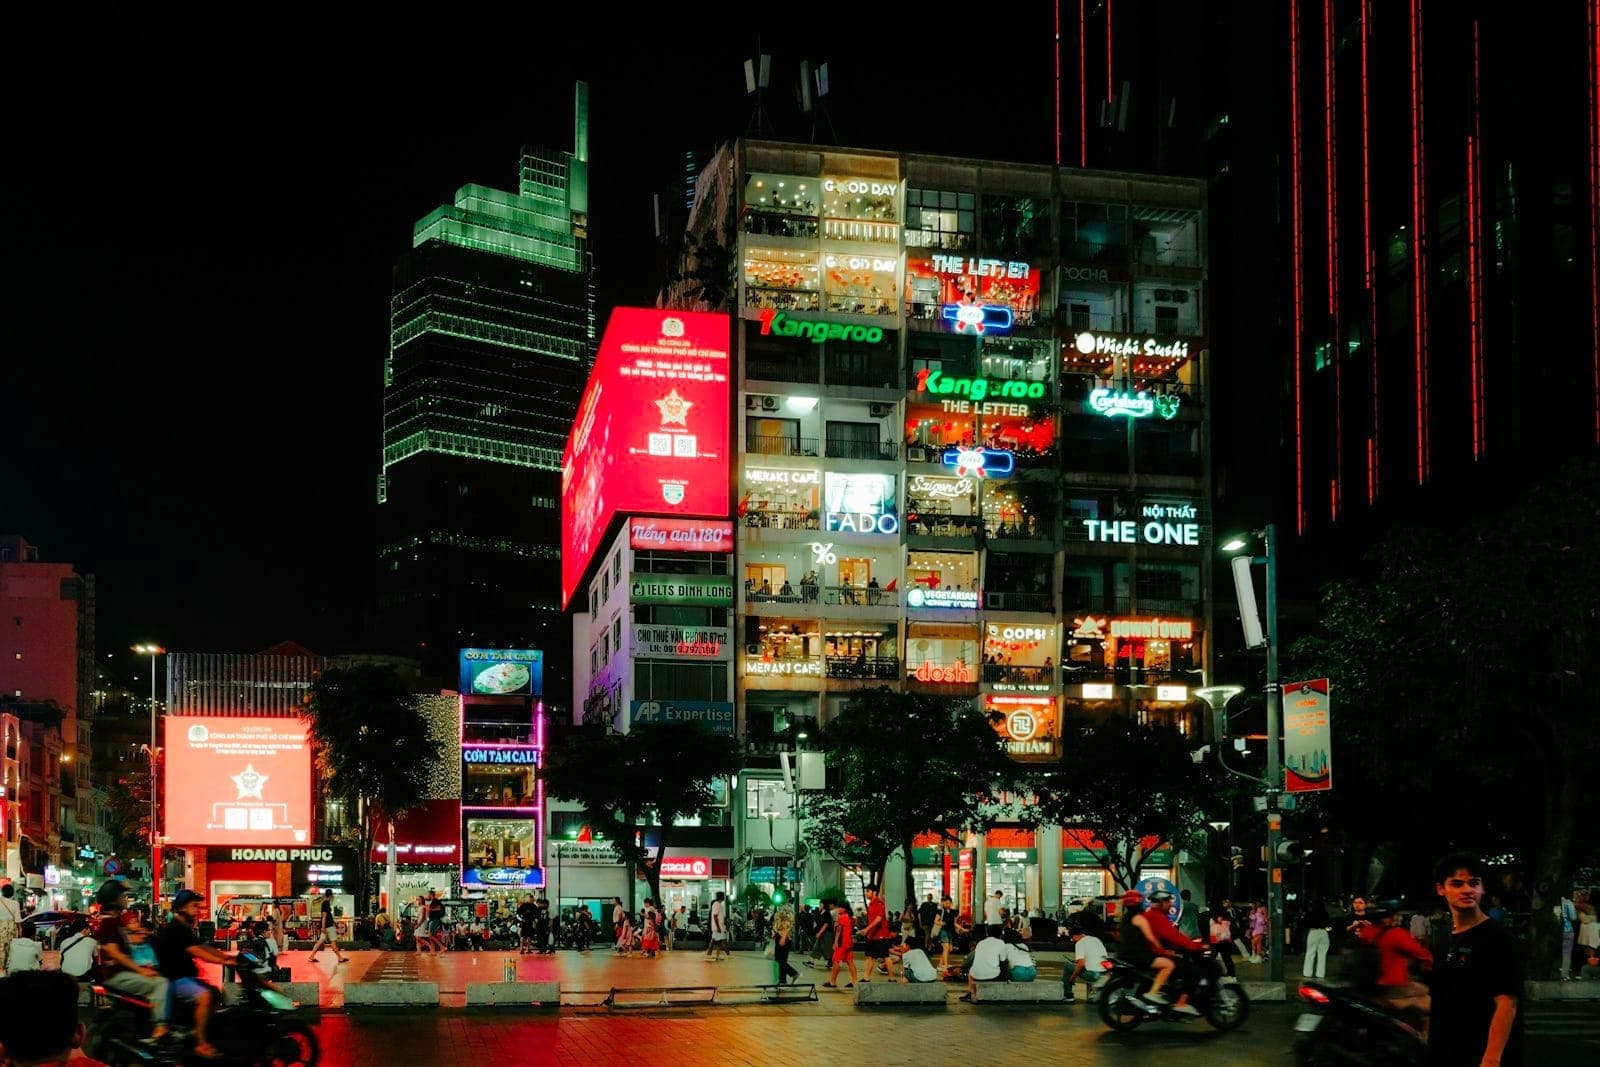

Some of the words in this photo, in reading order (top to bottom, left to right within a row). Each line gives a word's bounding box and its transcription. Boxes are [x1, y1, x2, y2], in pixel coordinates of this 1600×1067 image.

[871, 184, 897, 197] DAY
[872, 259, 897, 273] DAY
[932, 254, 963, 275] THE
[968, 257, 1029, 280] LETTER
[1097, 336, 1140, 356] Michi
[1143, 338, 1188, 358] Sushi
[941, 399, 970, 414] THE
[974, 401, 1028, 418] LETTER
[745, 470, 788, 483] MERAKI
[1142, 504, 1163, 520] NỘI
[1165, 505, 1198, 519] THẤT
[826, 512, 898, 534] FADO
[1083, 519, 1136, 543] THE
[1143, 522, 1199, 546] ONE
[648, 583, 675, 596] IELTS
[678, 582, 703, 597] ĐÌNH
[706, 585, 732, 598] LONG
[924, 590, 977, 601] VEGETARIAN
[637, 629, 651, 643] CHO
[1001, 628, 1046, 642] OOPS!
[746, 661, 792, 674] MERAKI
[915, 660, 971, 684] dosh
[665, 706, 732, 722] Expertise
[463, 749, 488, 763] CƠM
[512, 750, 537, 763] CALI
[231, 849, 288, 862] HOANG
[290, 849, 333, 862] PHUC
[660, 863, 691, 872] CIRCLE
[692, 861, 705, 875] K
